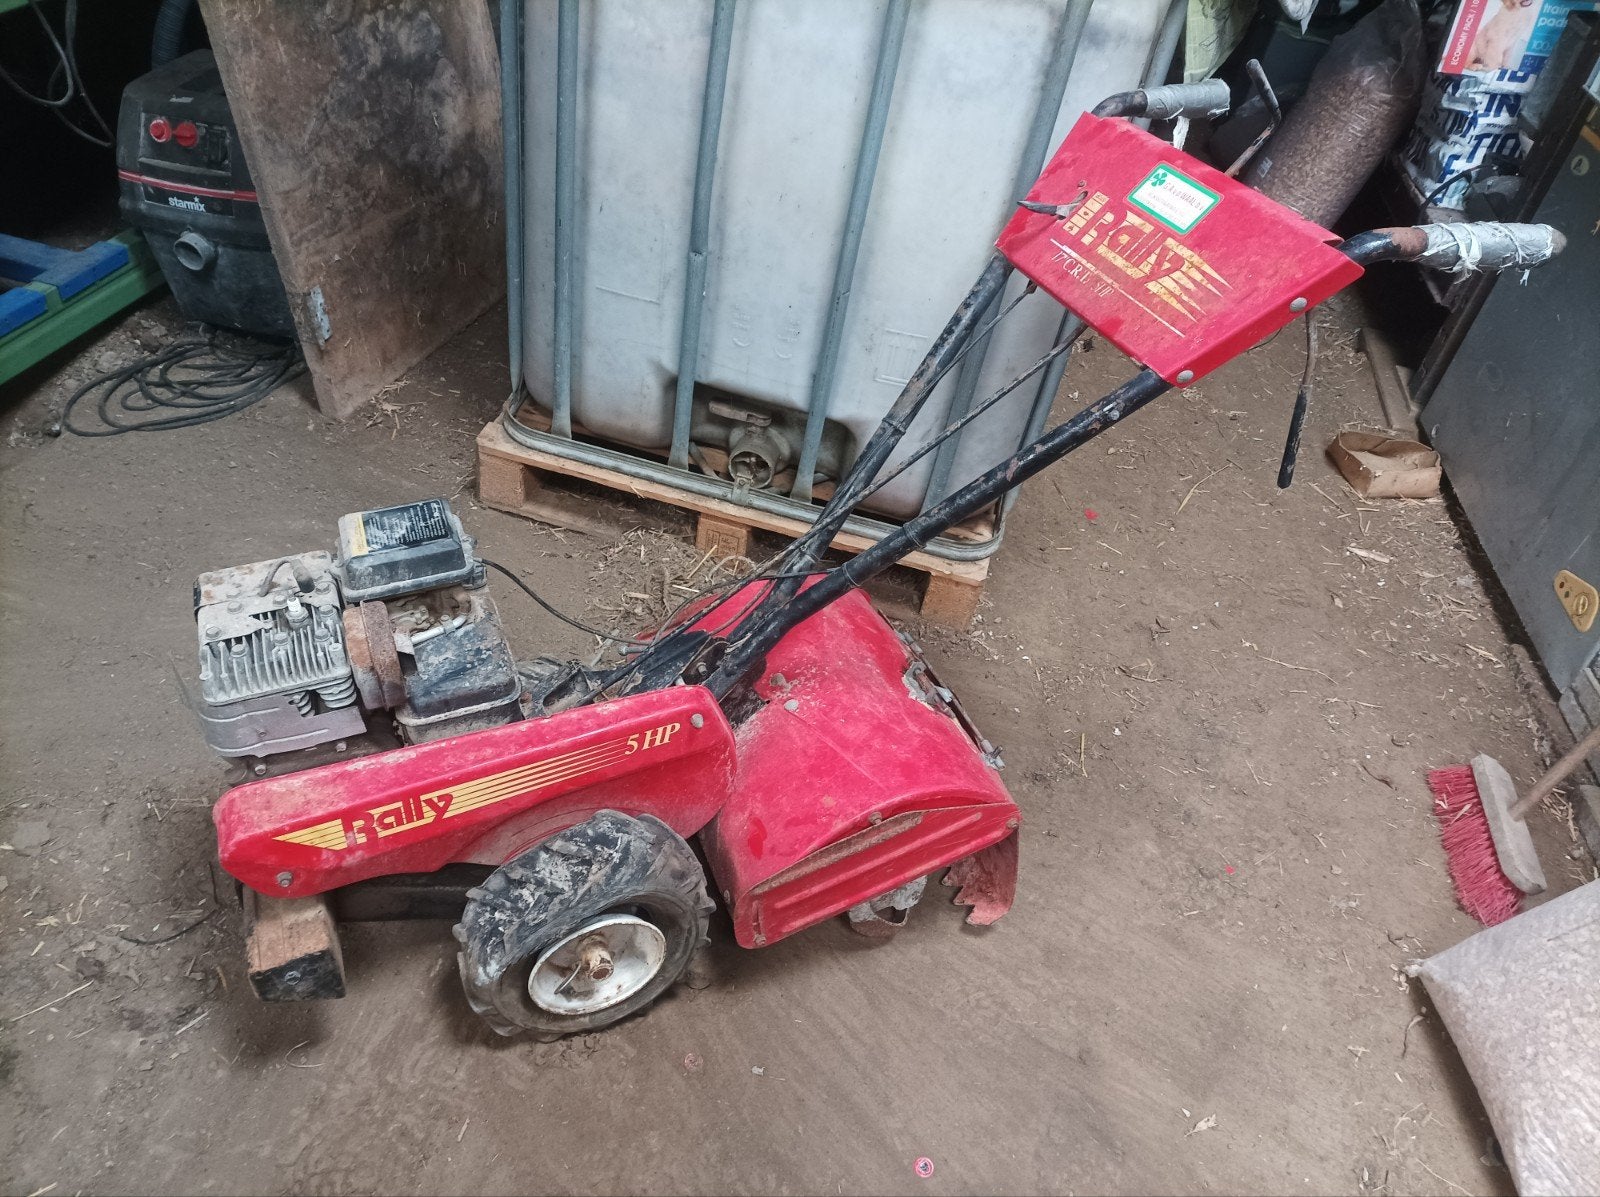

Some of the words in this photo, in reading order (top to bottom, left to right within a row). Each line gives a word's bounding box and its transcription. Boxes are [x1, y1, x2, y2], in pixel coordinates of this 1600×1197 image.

[1451, 31, 1469, 66] ECONOMY
[1463, 13, 1476, 31] PACK
[168, 196, 206, 212] starmix
[1075, 198, 1186, 285] Rally
[624, 733, 640, 755] 5
[641, 722, 681, 751] HP
[341, 793, 455, 848] Rally
